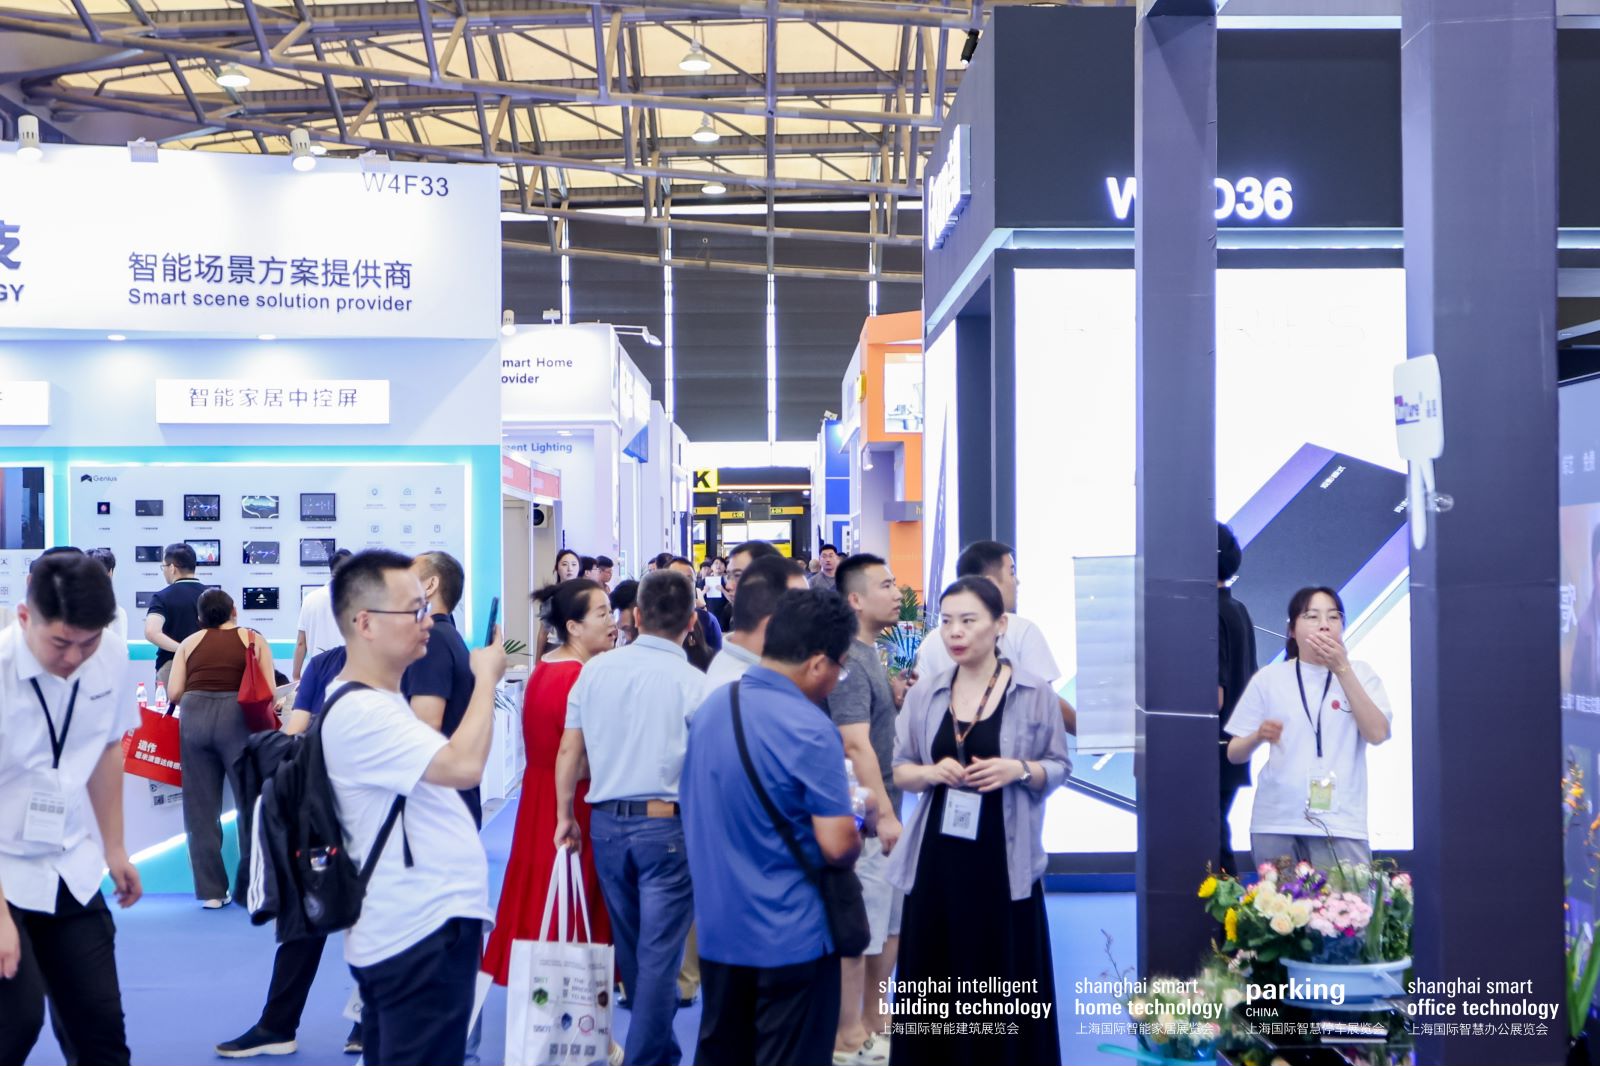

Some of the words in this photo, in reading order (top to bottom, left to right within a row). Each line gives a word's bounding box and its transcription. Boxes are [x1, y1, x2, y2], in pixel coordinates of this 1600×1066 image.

[362, 172, 449, 197] W4F33
[1106, 176, 1294, 220] WD36
[128, 251, 413, 290] 智能场景方案提供商
[128, 288, 187, 307] Smart
[193, 291, 250, 308] scene
[256, 290, 331, 311] solution
[336, 292, 413, 313] provider
[536, 357, 574, 368] Home
[189, 387, 359, 409] 智能家居中控屏
[531, 442, 573, 454] Lighting
